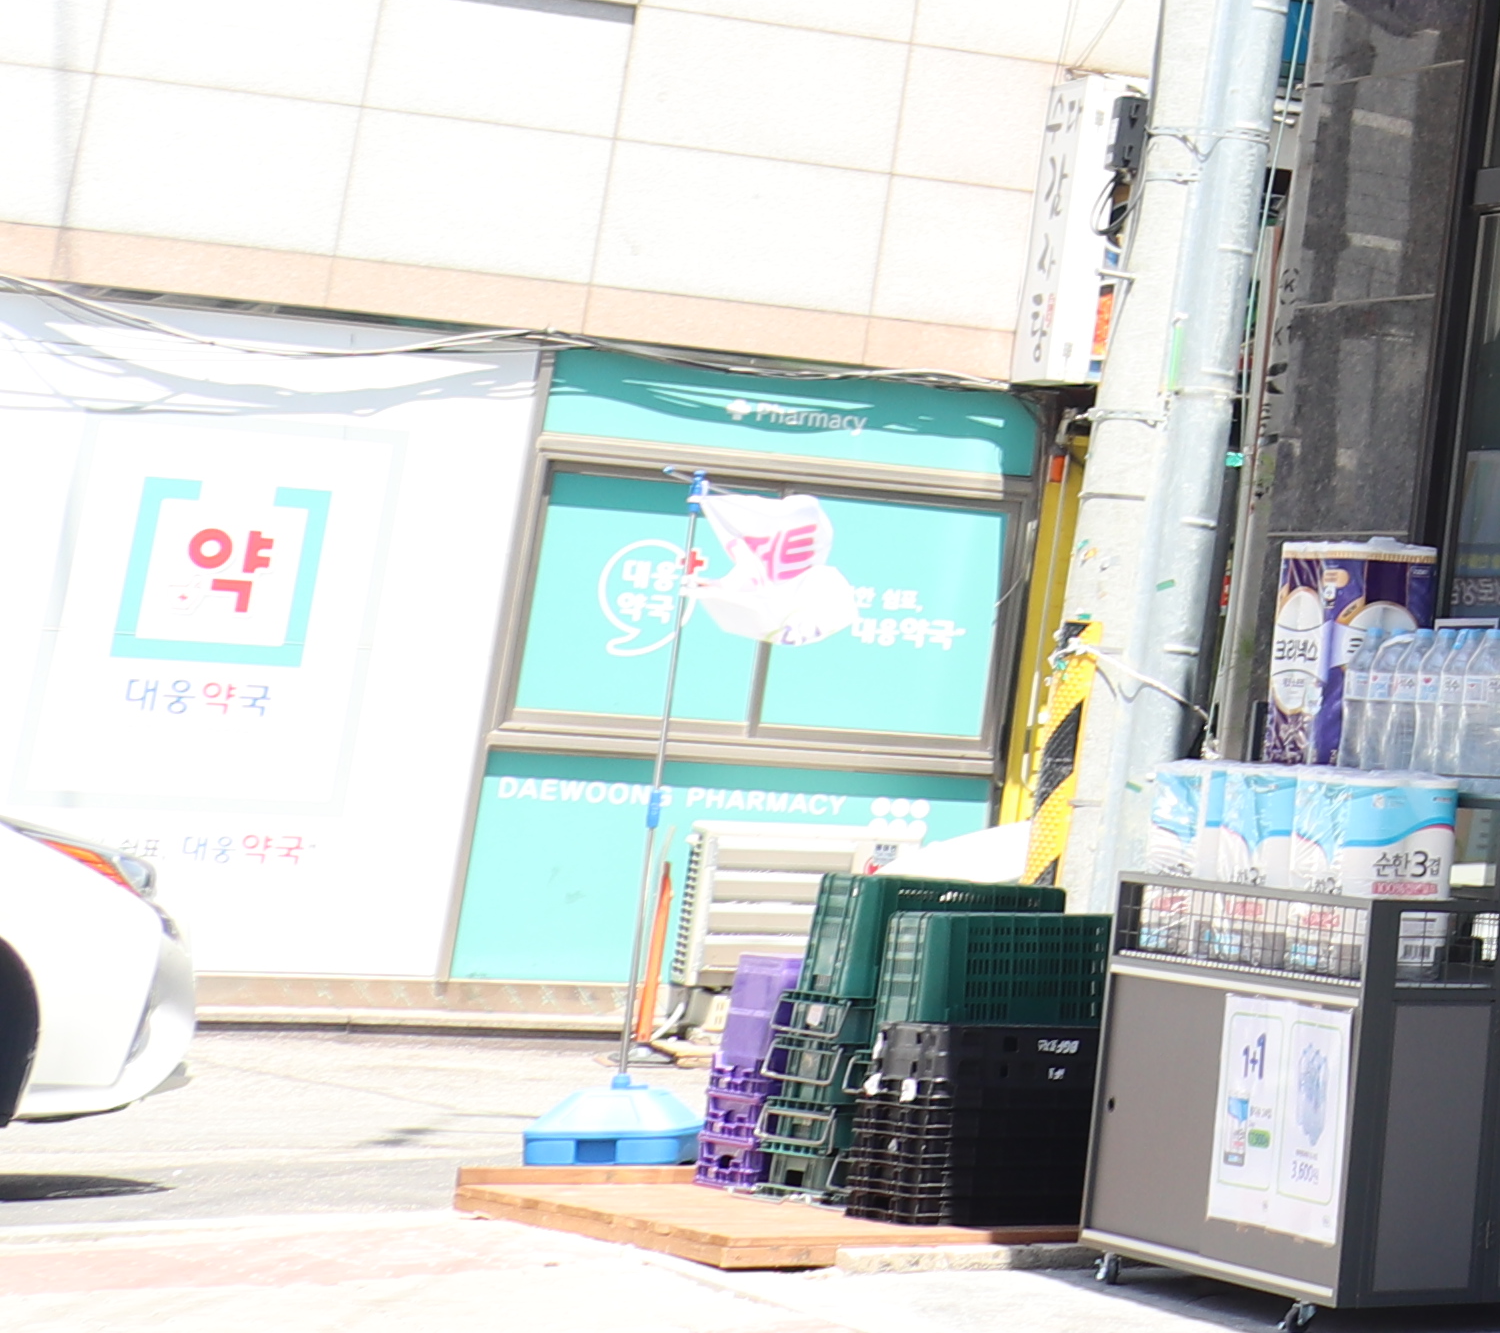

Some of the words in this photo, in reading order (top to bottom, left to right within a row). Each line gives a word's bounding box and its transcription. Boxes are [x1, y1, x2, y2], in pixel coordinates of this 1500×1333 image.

[754, 401, 868, 436] Pharmacy
[188, 528, 275, 613] 약
[616, 592, 676, 625] 약국
[850, 615, 957, 651] 대웅약국
[1273, 637, 1319, 663] 크리넥스
[124, 677, 273, 717] 대웅약국
[497, 774, 674, 808] DAEWOONG
[684, 785, 848, 818] PHARMACY
[182, 833, 304, 866] 대웅약국
[1242, 1032, 1267, 1081] 1+1
